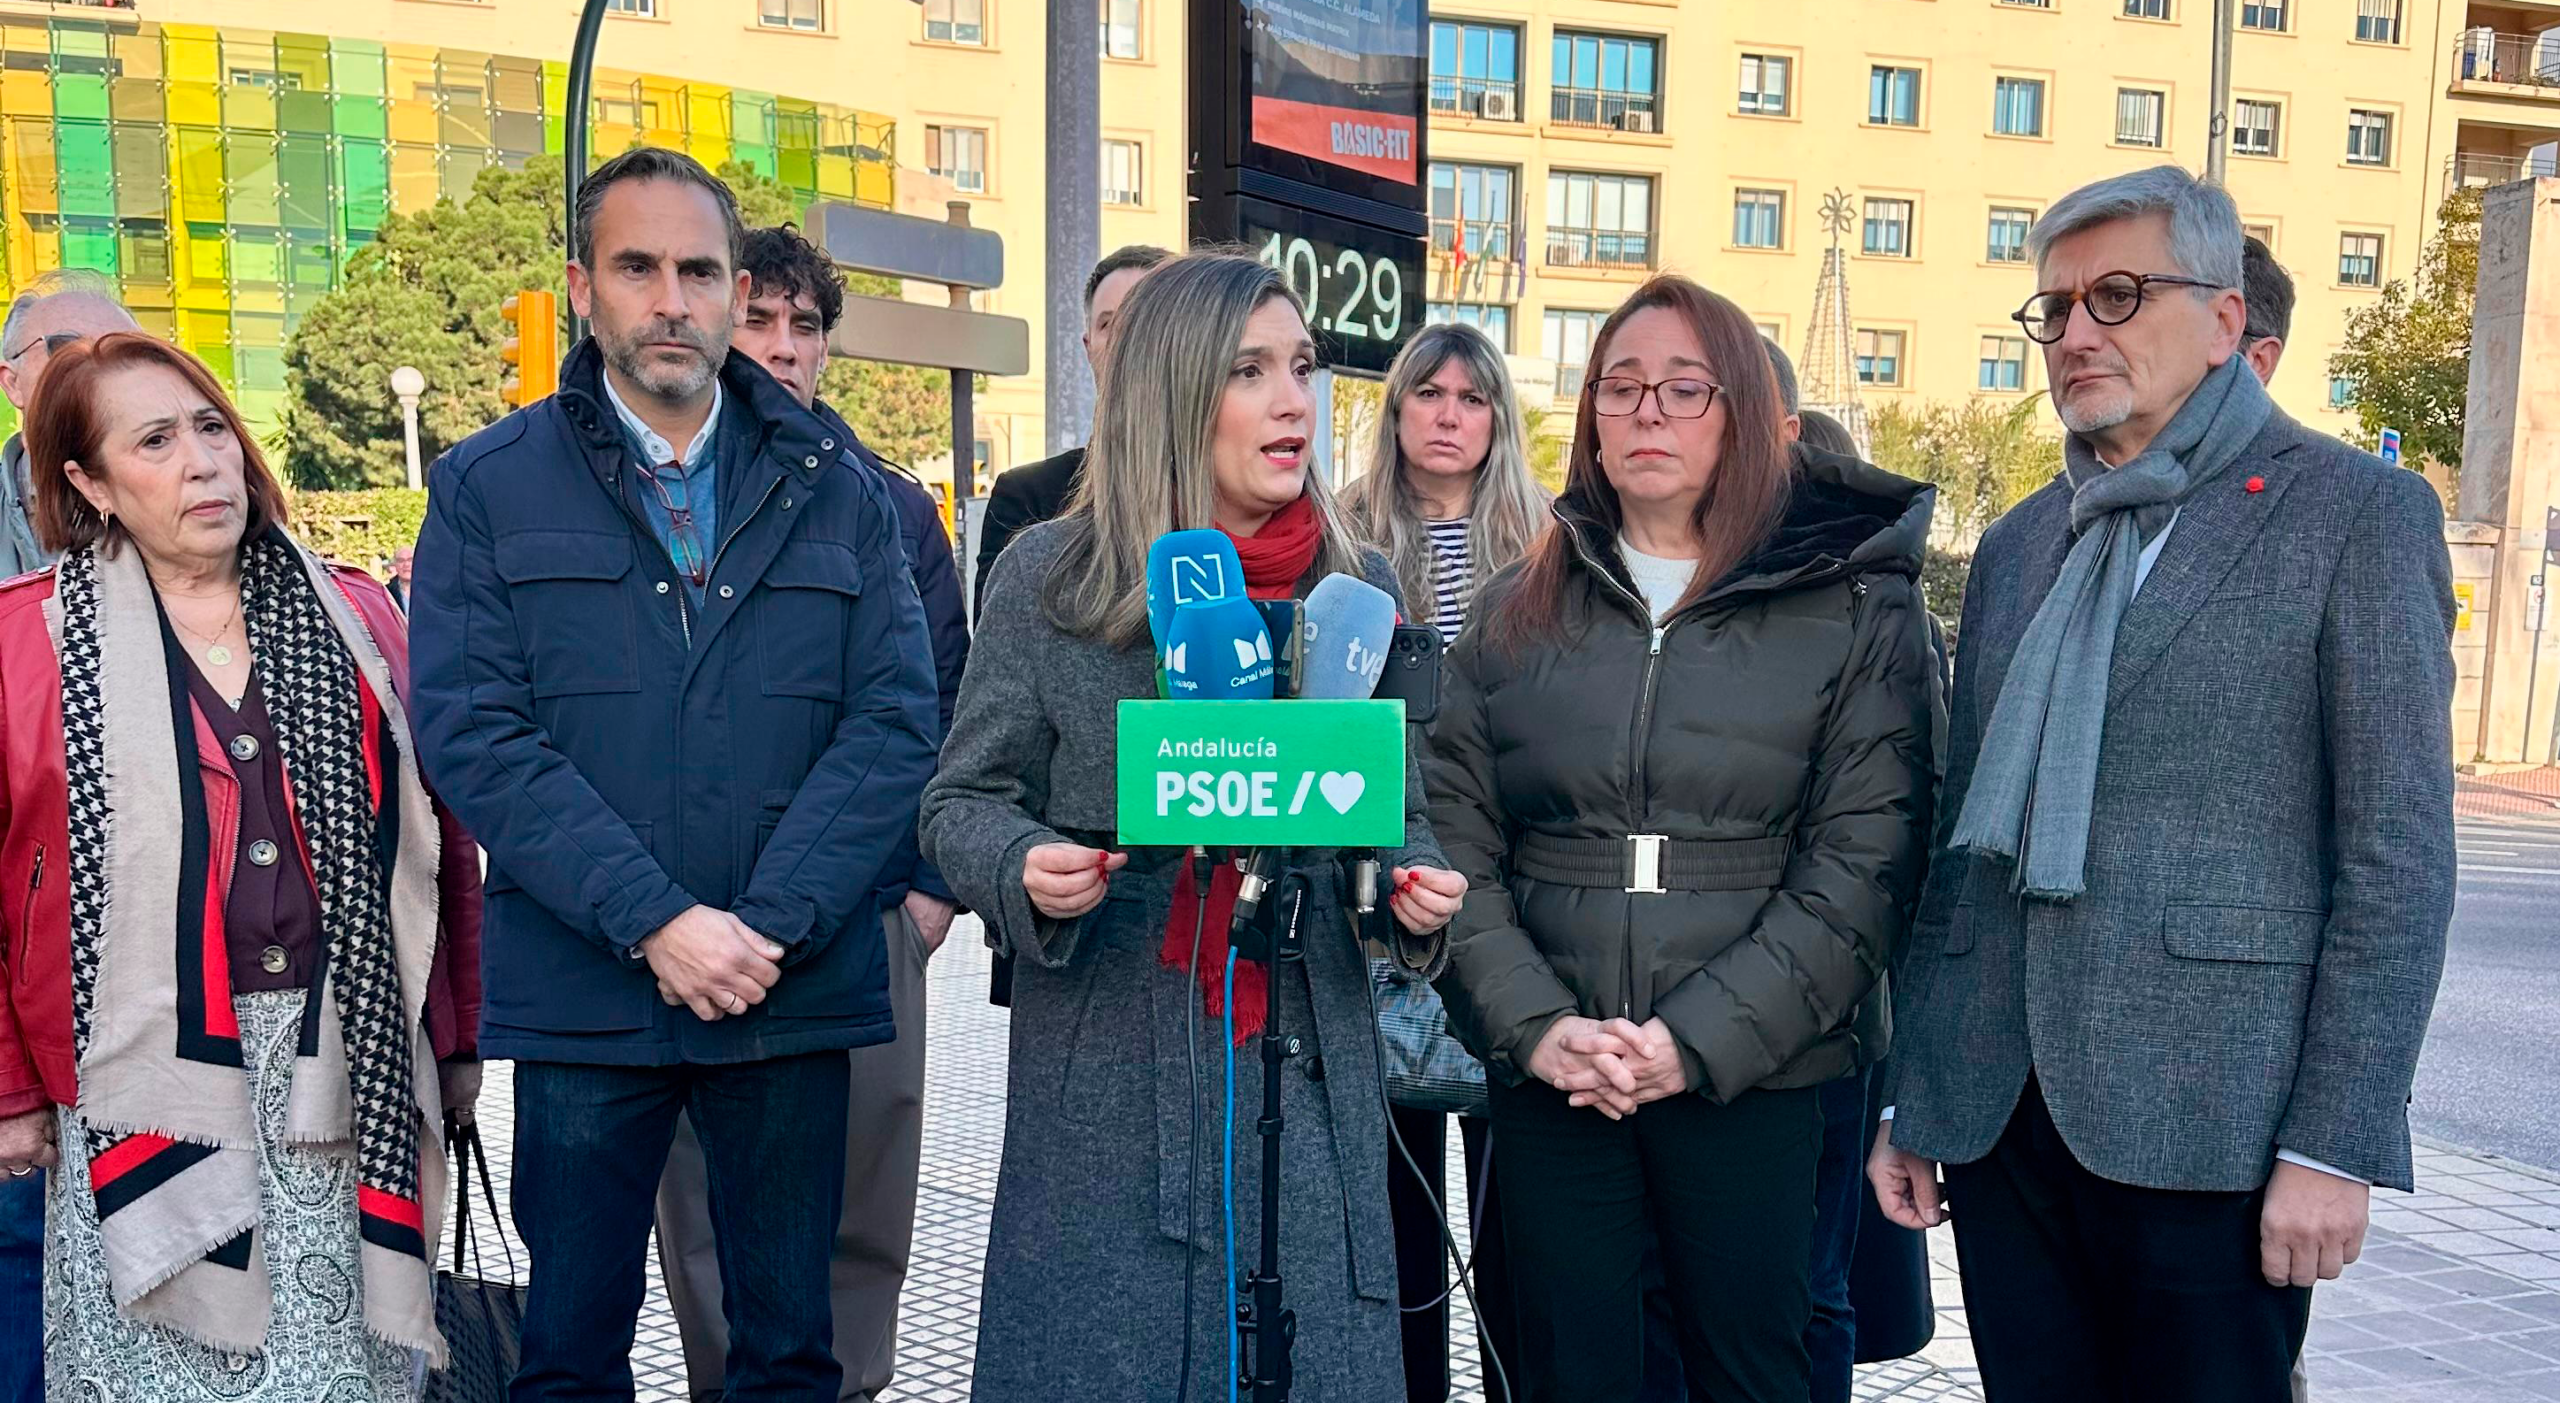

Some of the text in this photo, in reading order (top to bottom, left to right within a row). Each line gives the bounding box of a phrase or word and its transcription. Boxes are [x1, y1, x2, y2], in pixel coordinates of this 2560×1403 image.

[1293, 9, 1326, 30] MÁQUINAS
[1343, 3, 1381, 25] ALAMEDA
[1309, 38, 1327, 52] PARA
[1260, 232, 1402, 341] 10:29
[1231, 670, 1258, 687] Canal
[1157, 736, 1278, 758] Andalucía
[1156, 770, 1278, 817] PSOE
